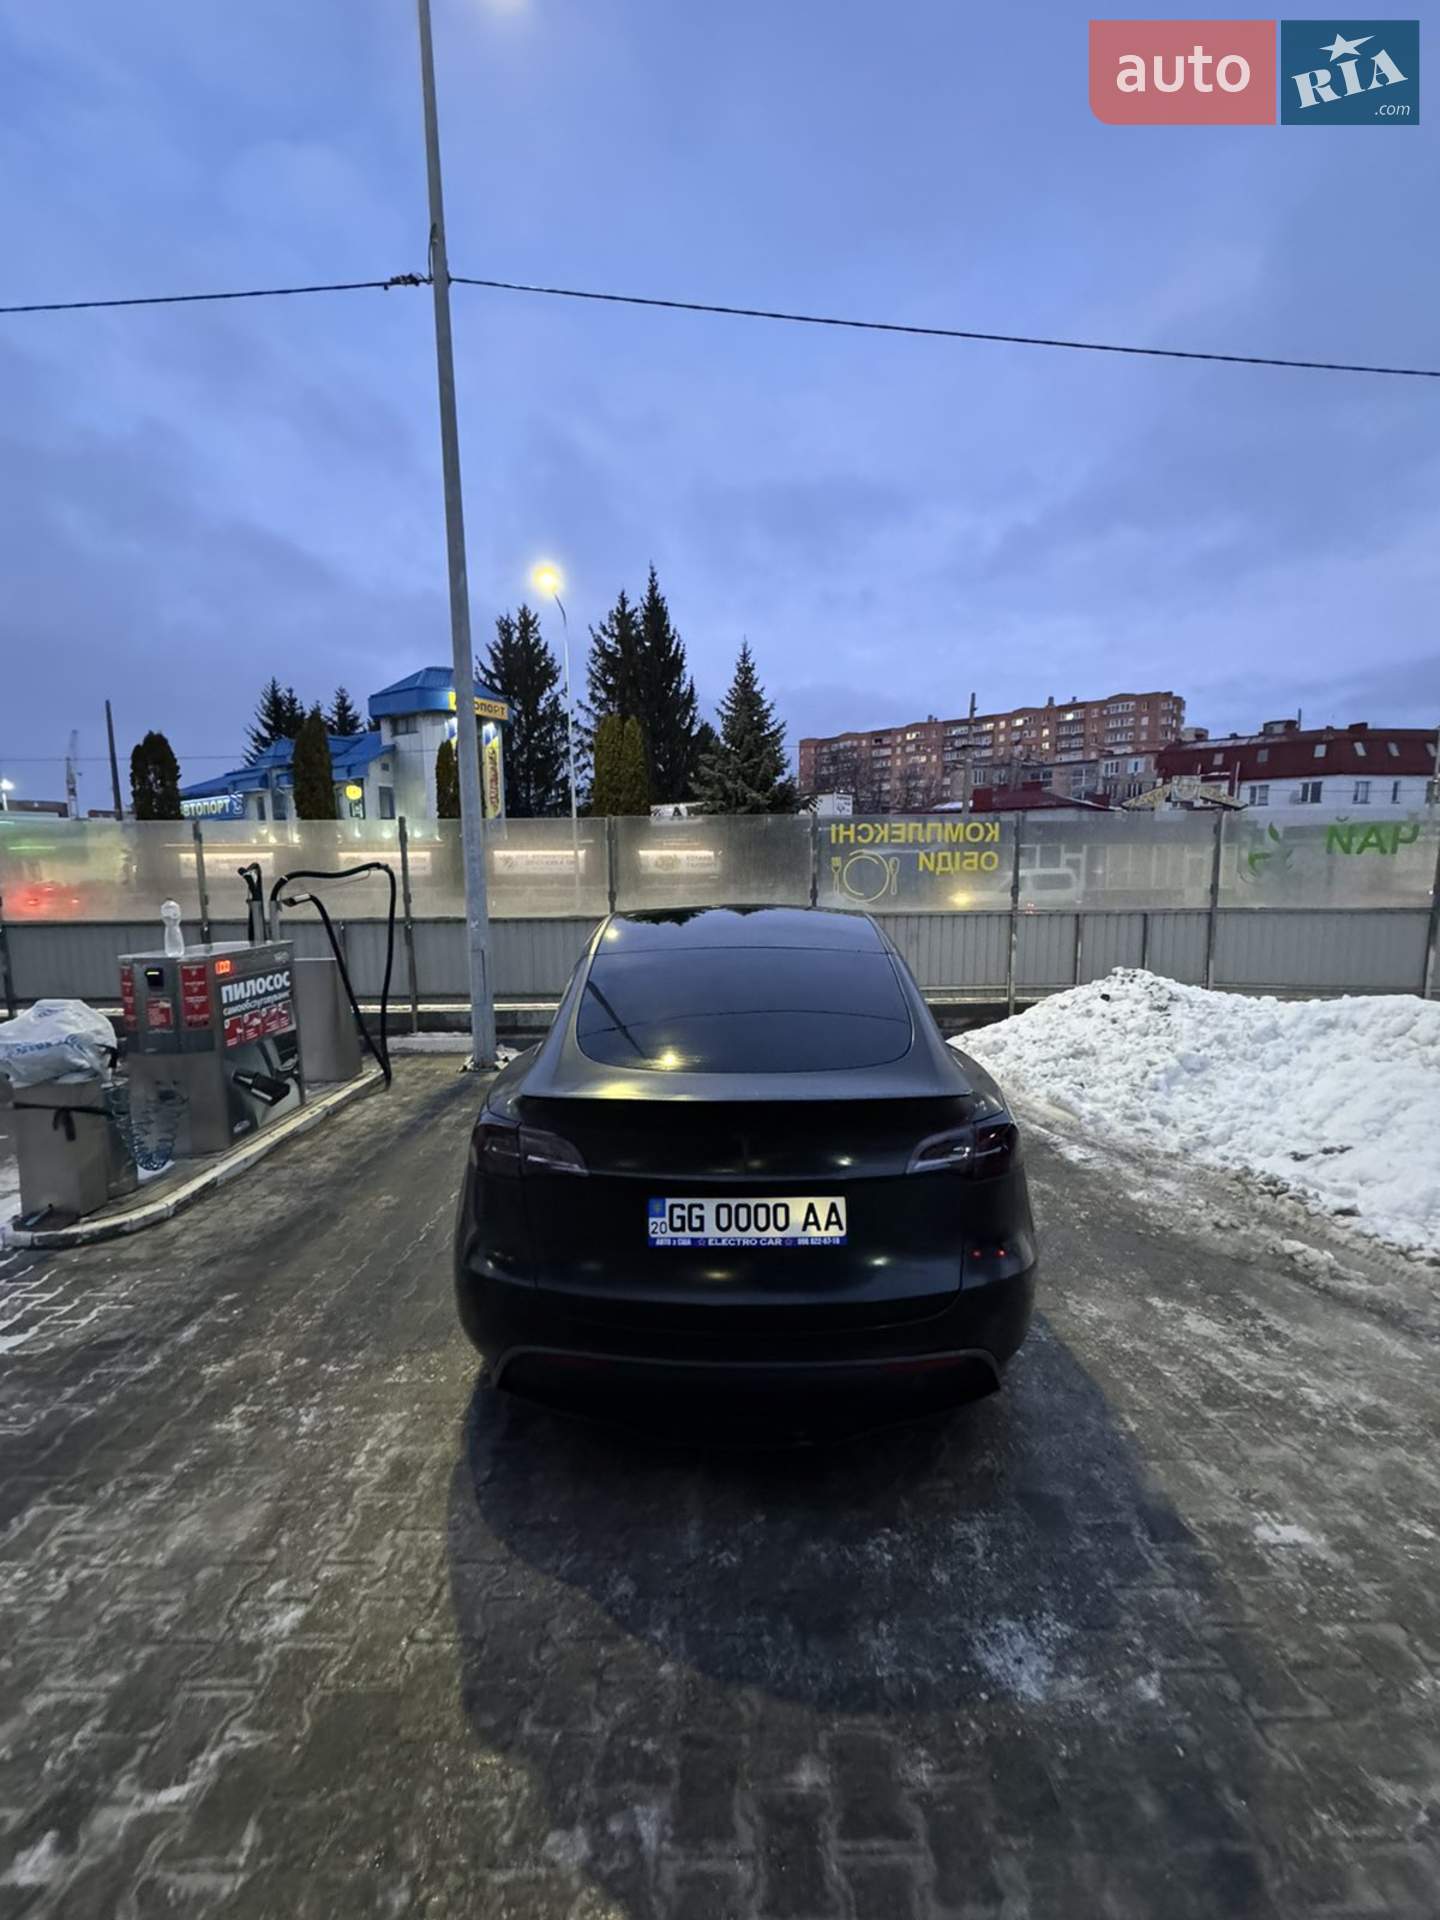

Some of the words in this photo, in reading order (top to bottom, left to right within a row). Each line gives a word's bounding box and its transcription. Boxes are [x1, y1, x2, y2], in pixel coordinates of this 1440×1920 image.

[473, 700, 505, 717] ОПОРТ
[221, 971, 291, 1004] ПИЛОСОС
[668, 1203, 705, 1233] GG
[715, 1203, 790, 1232] 0000
[802, 1202, 844, 1231] AA
[650, 1221, 667, 1235] 20
[708, 1238, 758, 1246] ELECTRO
[760, 1238, 782, 1246] CAR
